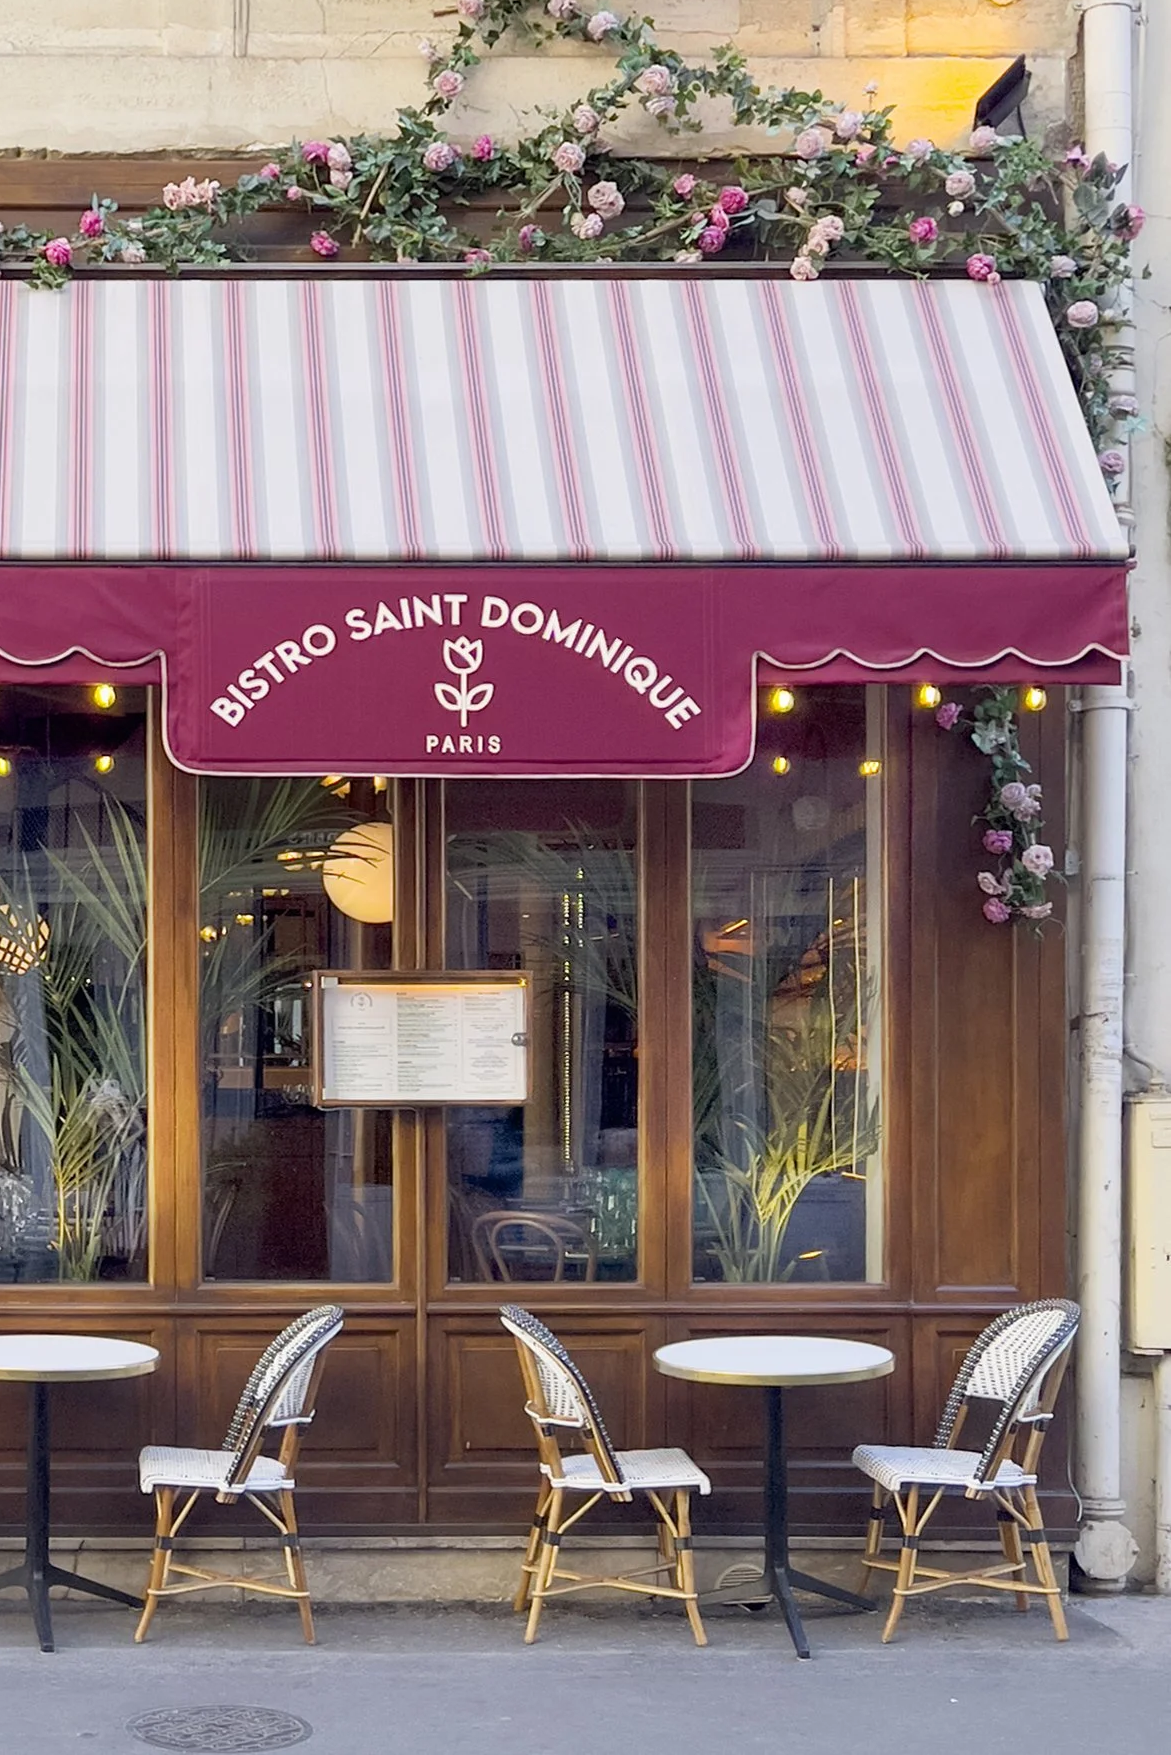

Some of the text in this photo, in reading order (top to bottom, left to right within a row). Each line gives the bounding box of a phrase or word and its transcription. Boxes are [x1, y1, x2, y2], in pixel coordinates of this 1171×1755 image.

[209, 593, 702, 730] BISTRO SAINT DOMINIQUE
[426, 735, 502, 754] PARIS
